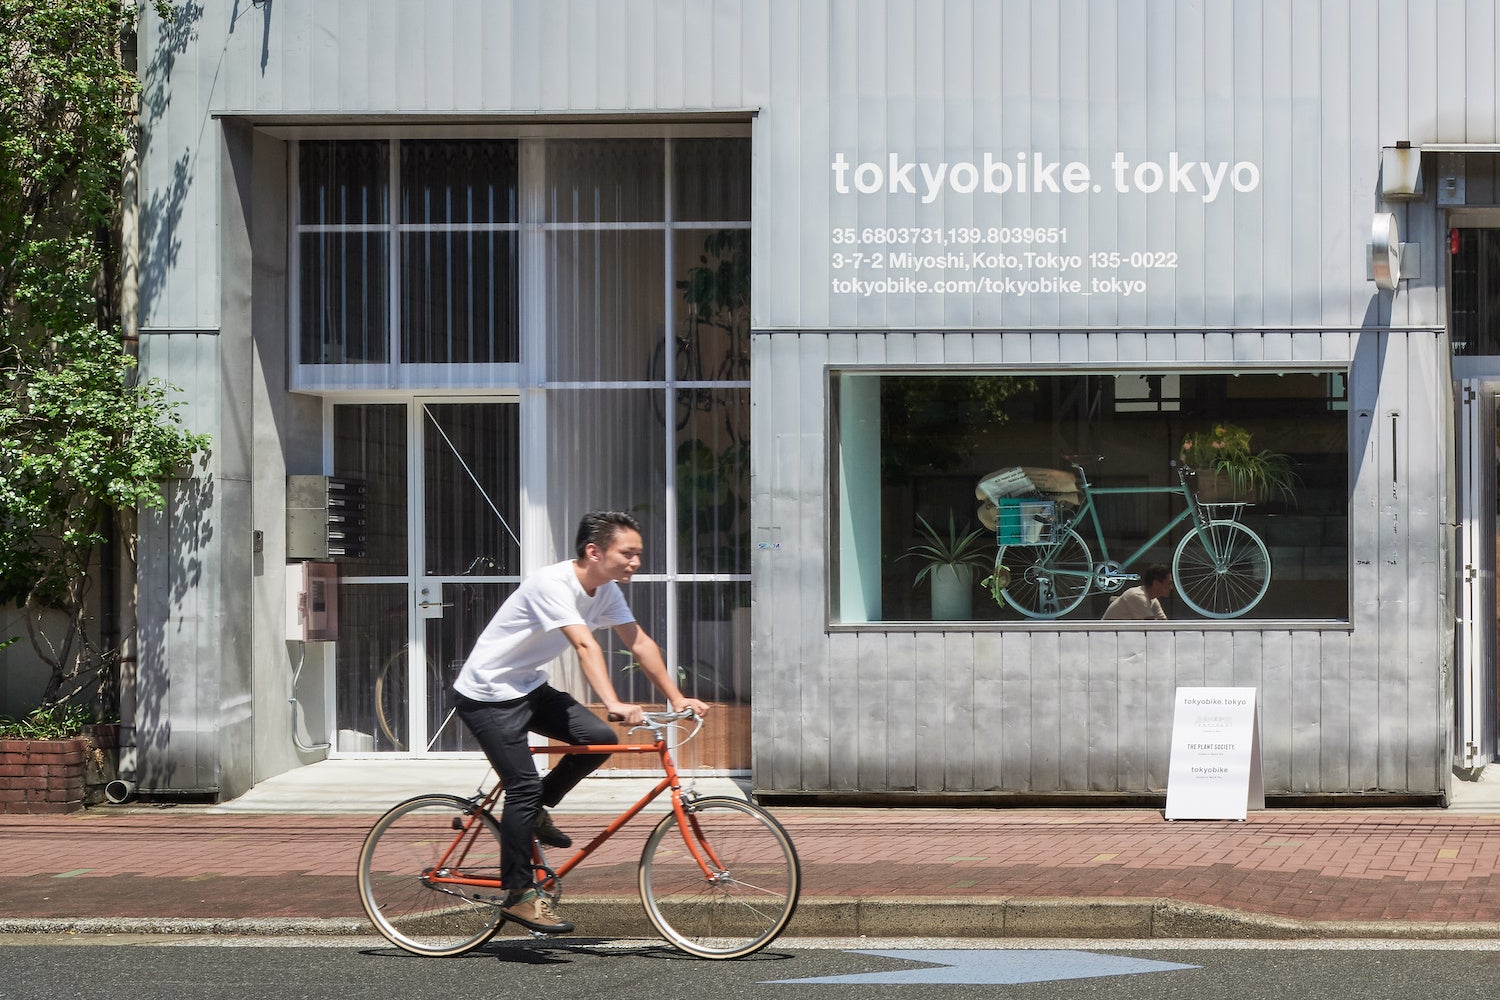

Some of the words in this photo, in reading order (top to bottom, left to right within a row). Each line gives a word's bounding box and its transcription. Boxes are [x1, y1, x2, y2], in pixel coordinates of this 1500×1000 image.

[832, 253, 883, 269] 3-7-2
[1089, 252, 1178, 269] 135-0022
[832, 277, 1146, 297] tokyobike.com/tokyobike_tokyo
[1191, 766, 1229, 774] tokyobike
